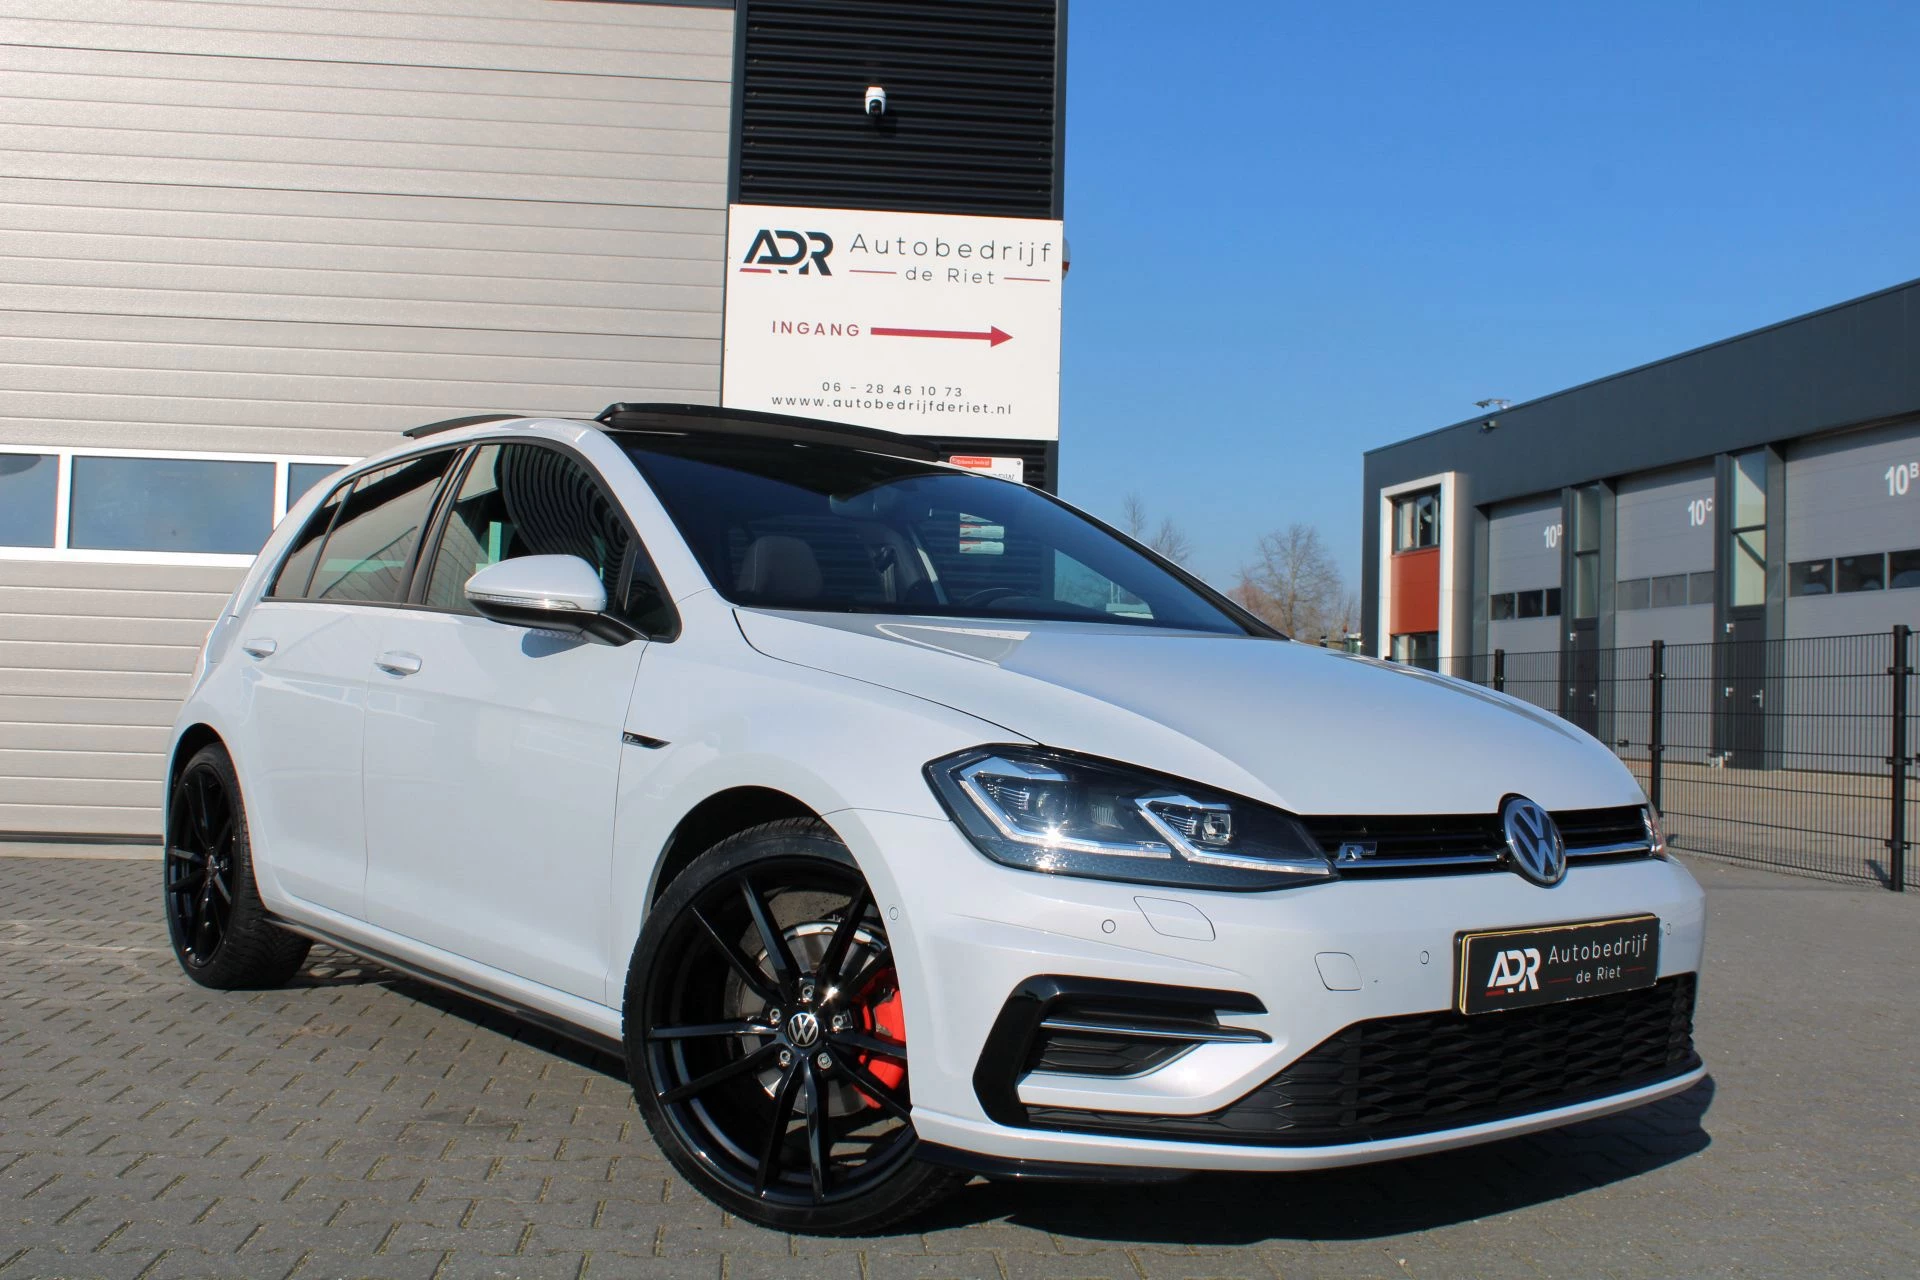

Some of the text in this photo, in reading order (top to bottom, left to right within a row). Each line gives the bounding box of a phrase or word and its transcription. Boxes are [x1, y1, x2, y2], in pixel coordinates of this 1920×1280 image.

[743, 229, 834, 276] ADR
[849, 233, 1052, 267] Autobedrijf
[905, 266, 995, 285] de Riet
[771, 320, 860, 337] INGANG
[821, 382, 842, 393] 06
[866, 383, 885, 394] 28
[893, 384, 912, 396] 46
[920, 386, 937, 397] 10
[944, 387, 963, 398] 73
[771, 396, 1012, 415] www.autobedrijfderiet.nl
[1548, 934, 1649, 965] Autobedrijf
[1487, 947, 1542, 993] ADR
[1576, 966, 1621, 984] de Riet
